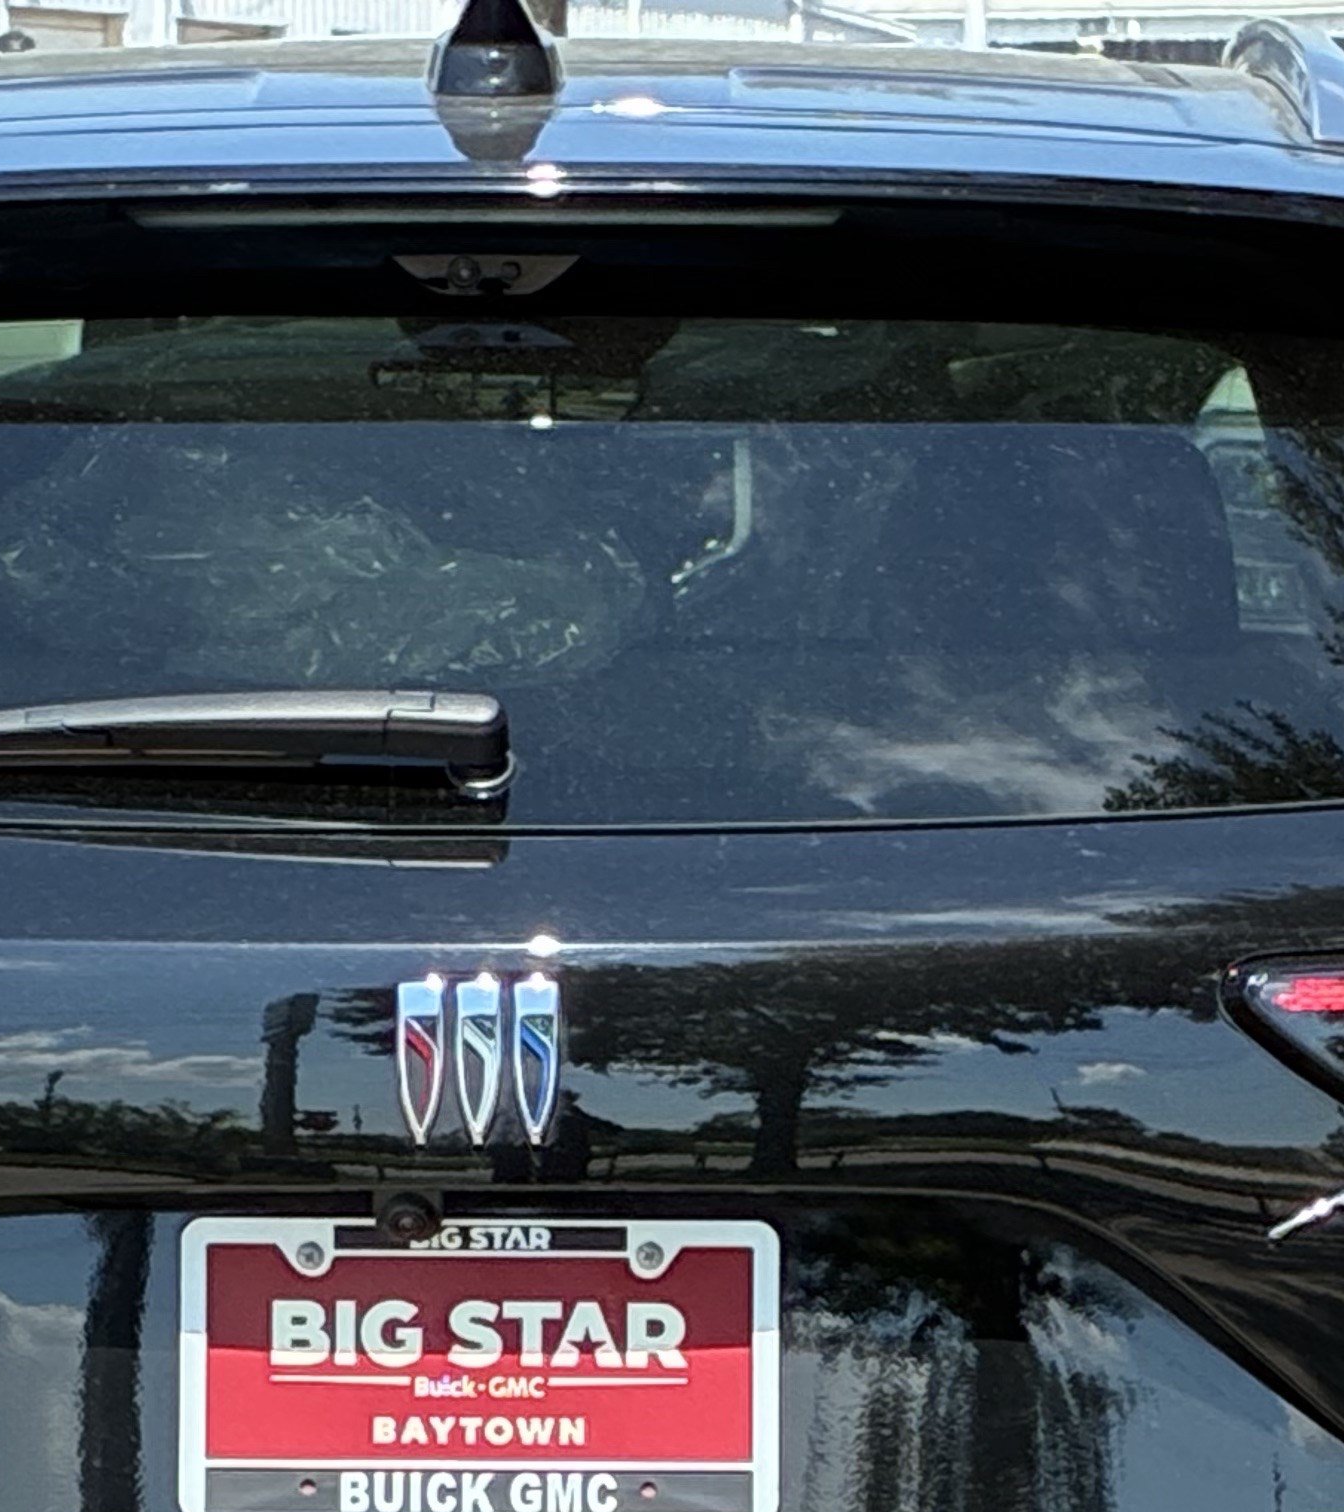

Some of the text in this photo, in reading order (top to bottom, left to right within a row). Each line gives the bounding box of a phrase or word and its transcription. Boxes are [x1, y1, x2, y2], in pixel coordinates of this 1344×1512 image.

[468, 1226, 552, 1250] STAR
[270, 1299, 689, 1369] BIG STAR
[371, 1415, 587, 1447] BAYTOWN
